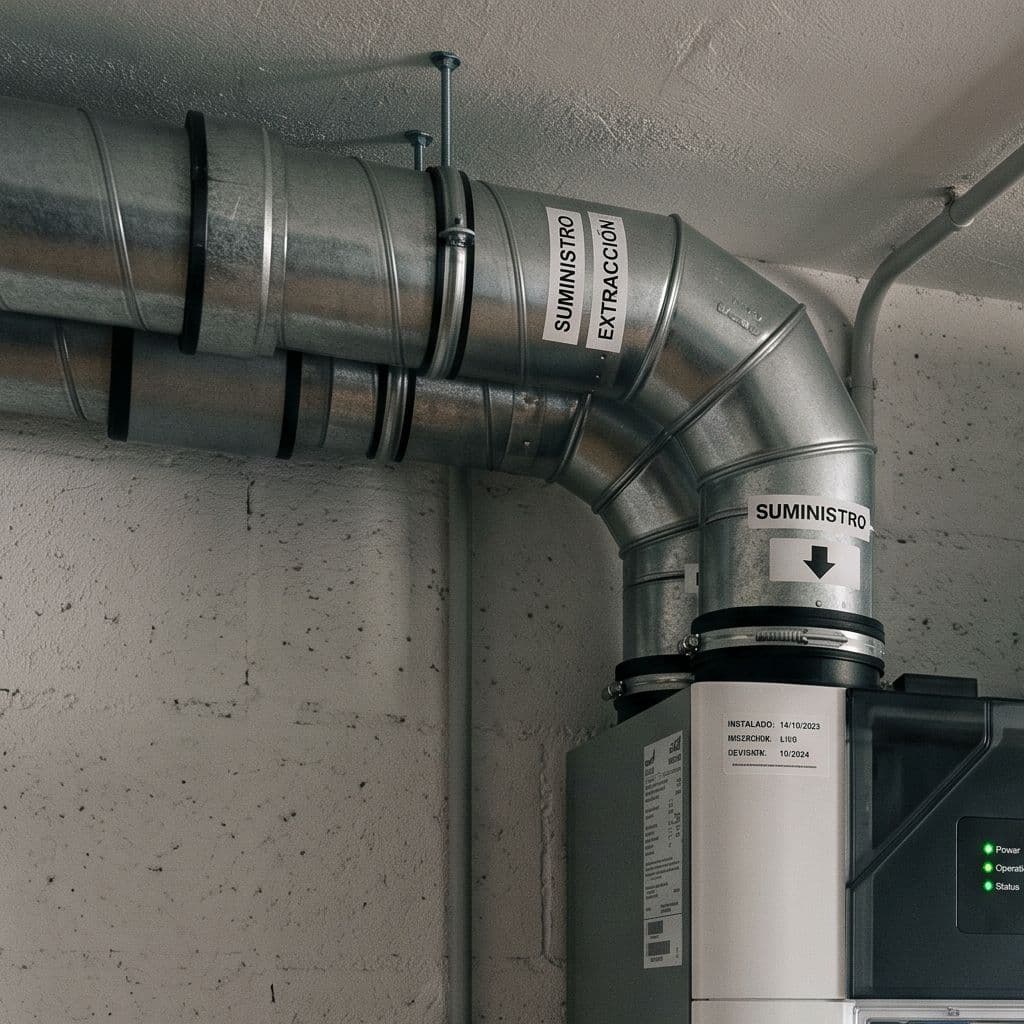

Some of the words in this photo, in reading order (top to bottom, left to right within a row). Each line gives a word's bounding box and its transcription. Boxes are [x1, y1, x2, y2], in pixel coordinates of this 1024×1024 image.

[554, 215, 576, 332] SUMINISTRO
[597, 219, 619, 340] EXTRACCIÓN
[756, 503, 867, 530] SUMINISTRO
[727, 720, 775, 729] INSTALADO:
[780, 721, 820, 730] 14/10/2023
[780, 750, 810, 758] 10/2024
